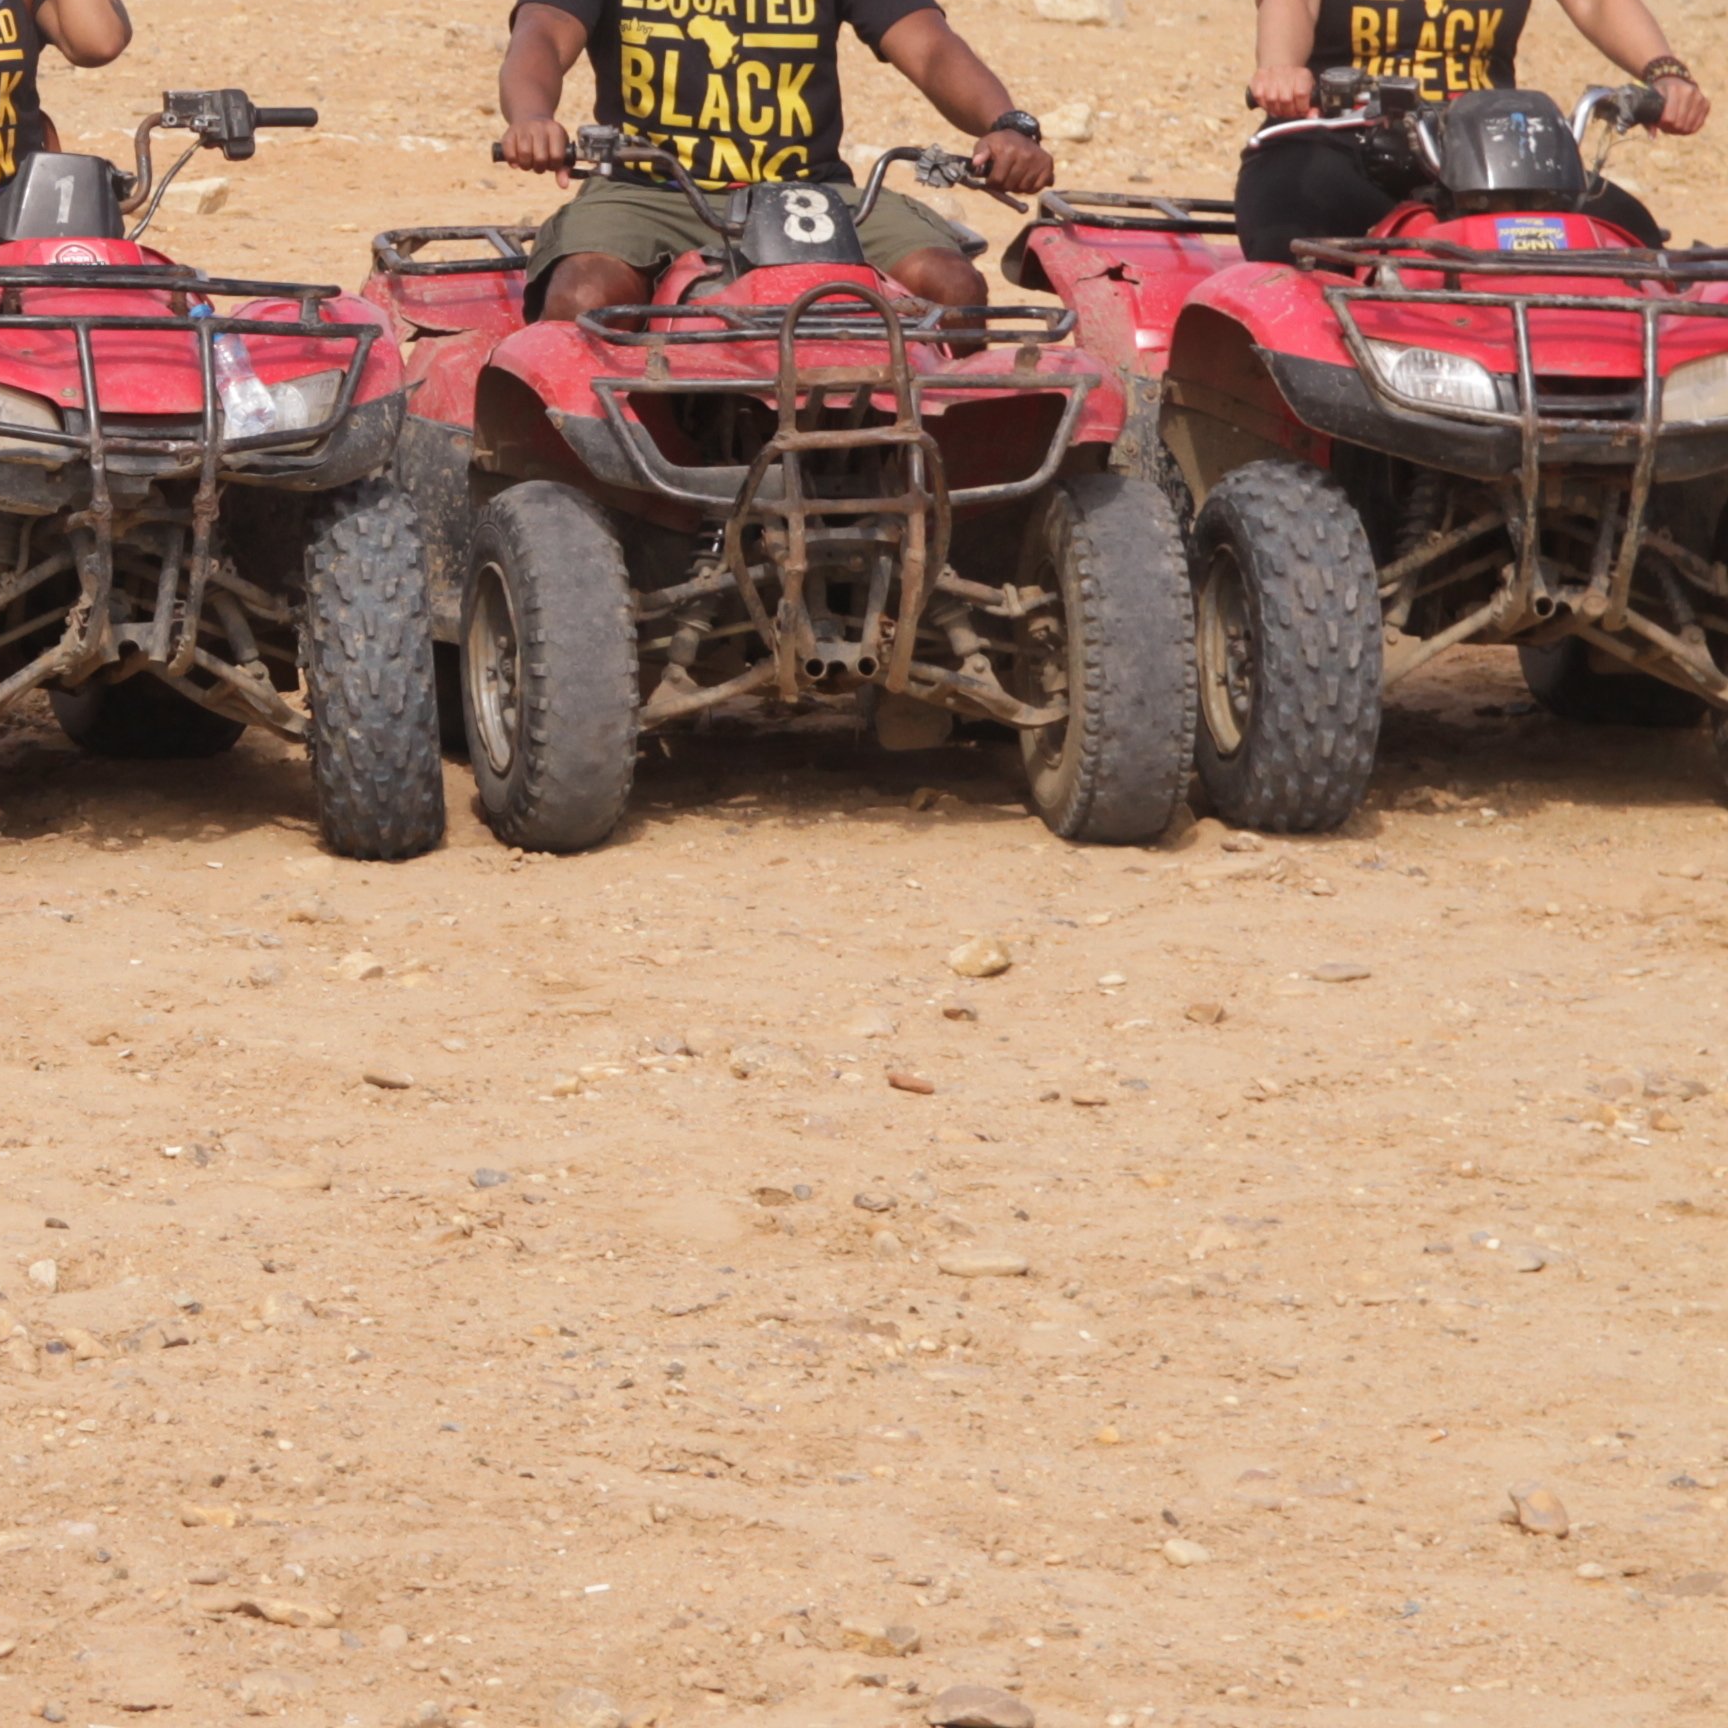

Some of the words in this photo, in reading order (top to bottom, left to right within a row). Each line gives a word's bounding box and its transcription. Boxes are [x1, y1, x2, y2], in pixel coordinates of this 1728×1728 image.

[1352, 6, 1503, 57] BLACK
[621, 44, 816, 136] BLACK
[55, 175, 75, 224] 1
[780, 188, 835, 243] 8
